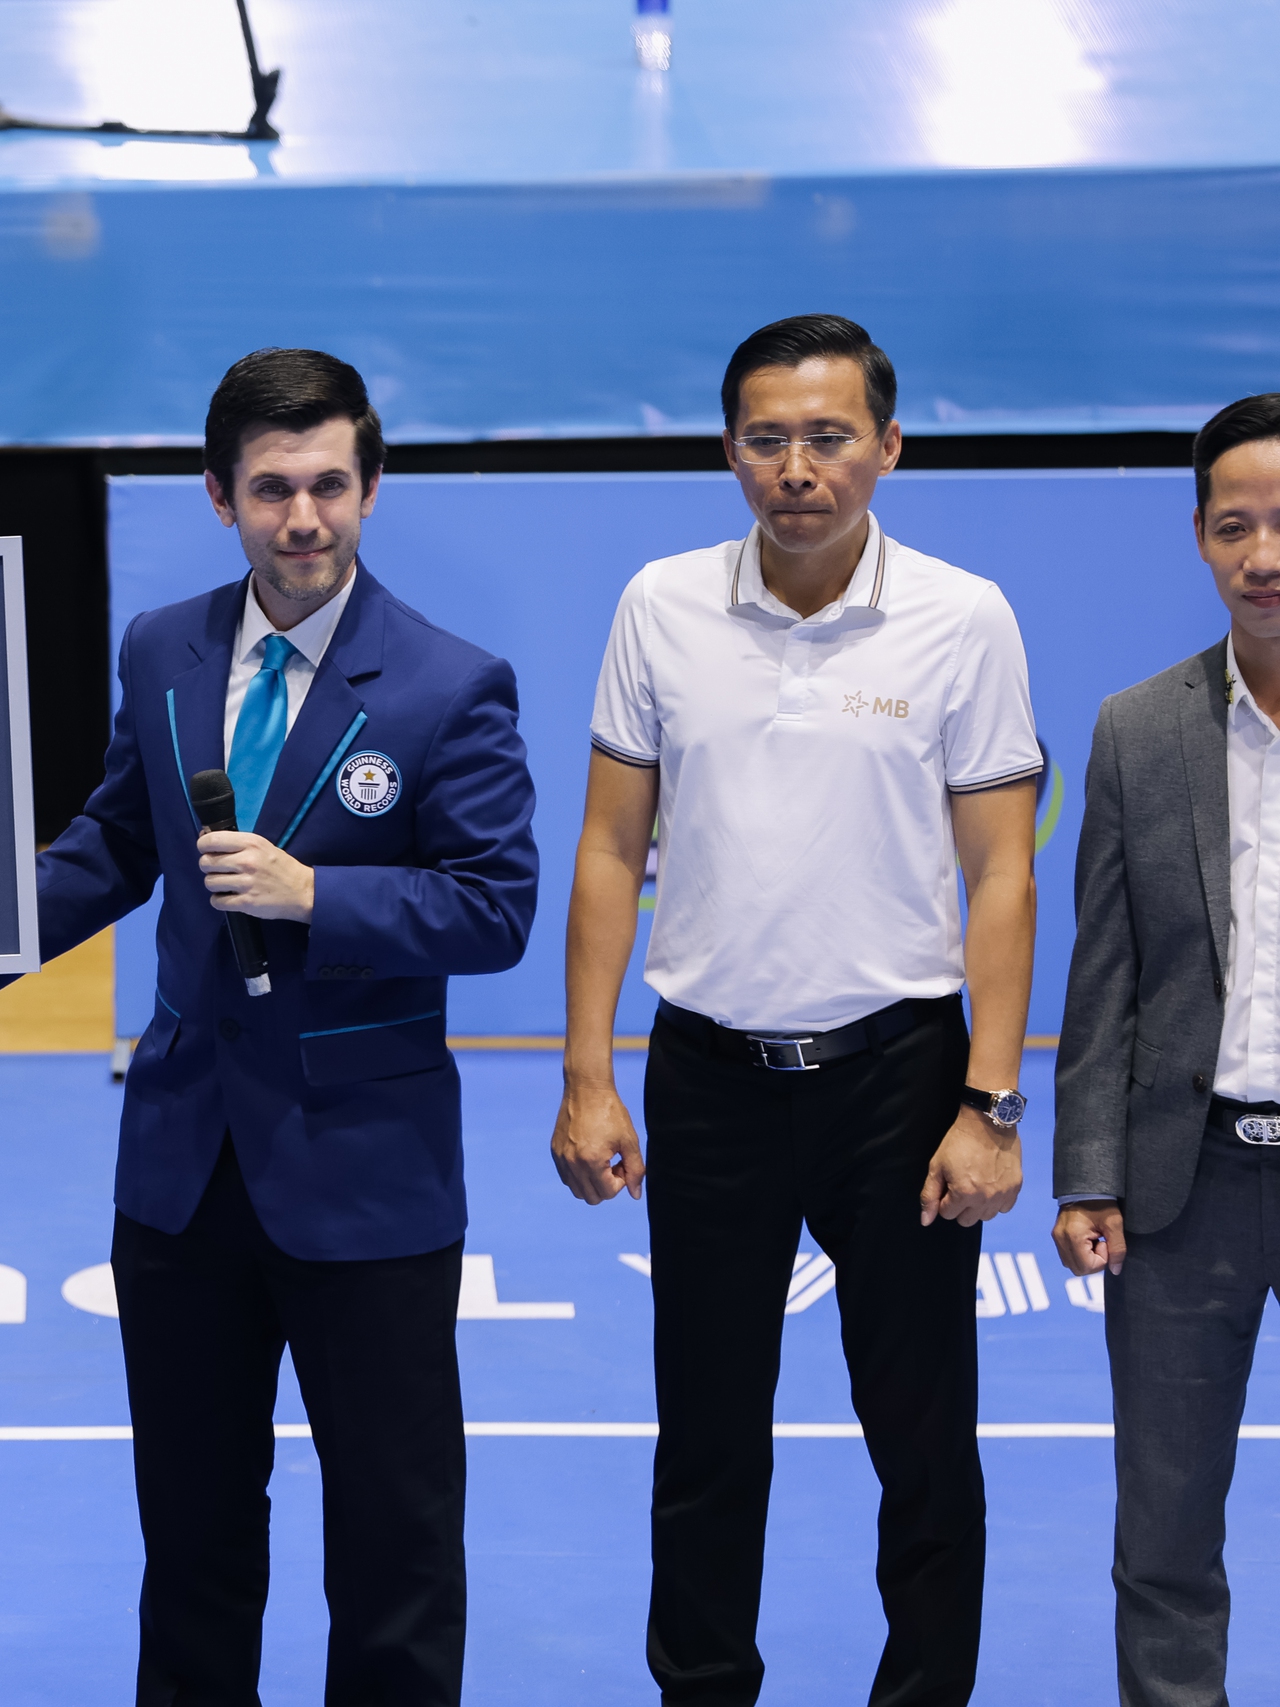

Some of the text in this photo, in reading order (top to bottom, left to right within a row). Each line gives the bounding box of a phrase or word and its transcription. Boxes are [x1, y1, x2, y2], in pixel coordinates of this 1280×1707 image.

[872, 696, 910, 719] MB
[347, 757, 393, 774] GUINNESS
[341, 779, 397, 812] WORLD RECORDS
